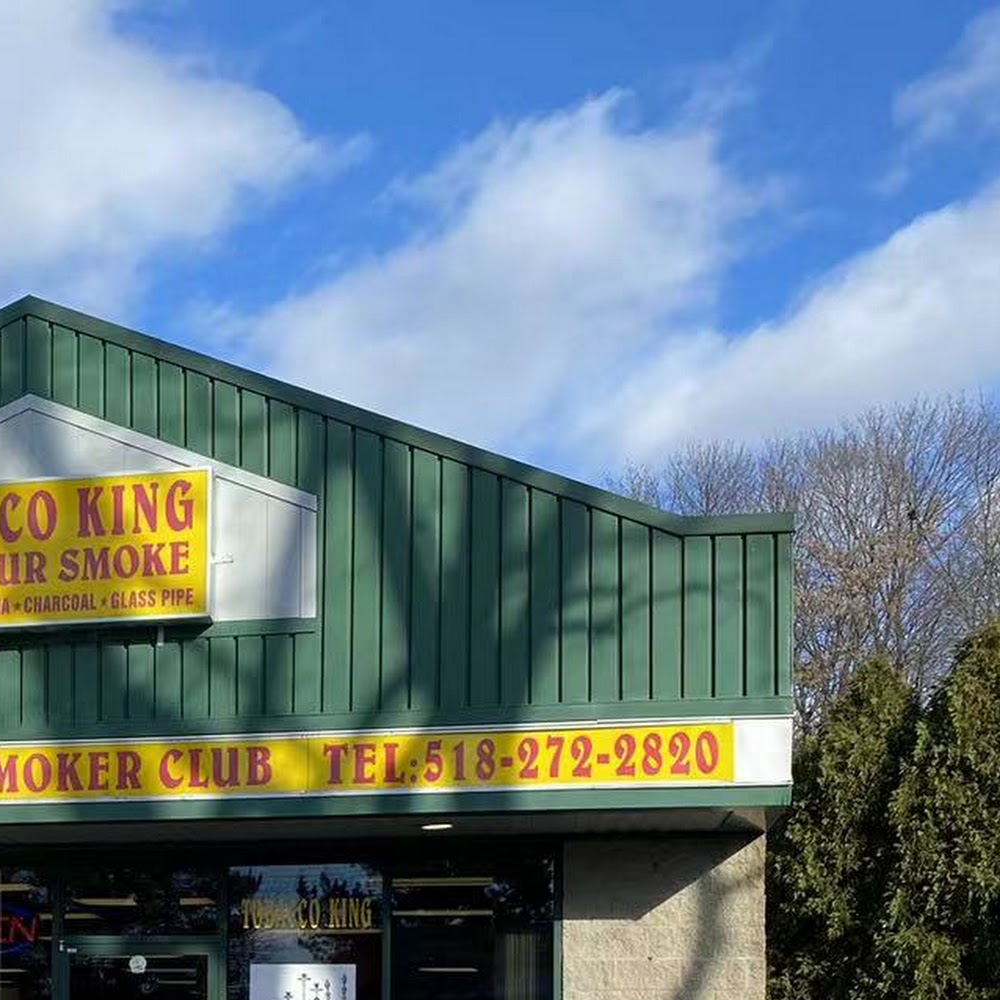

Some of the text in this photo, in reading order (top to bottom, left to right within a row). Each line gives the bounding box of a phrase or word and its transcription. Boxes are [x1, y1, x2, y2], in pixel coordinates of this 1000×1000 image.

[76, 479, 195, 535] KING
[58, 541, 190, 583] SMOKE
[23, 593, 97, 613] CHARCOAL
[111, 590, 156, 609] GLASS
[161, 588, 194, 606] PIPE
[159, 745, 272, 789] CLUB
[329, 898, 372, 929] KING
